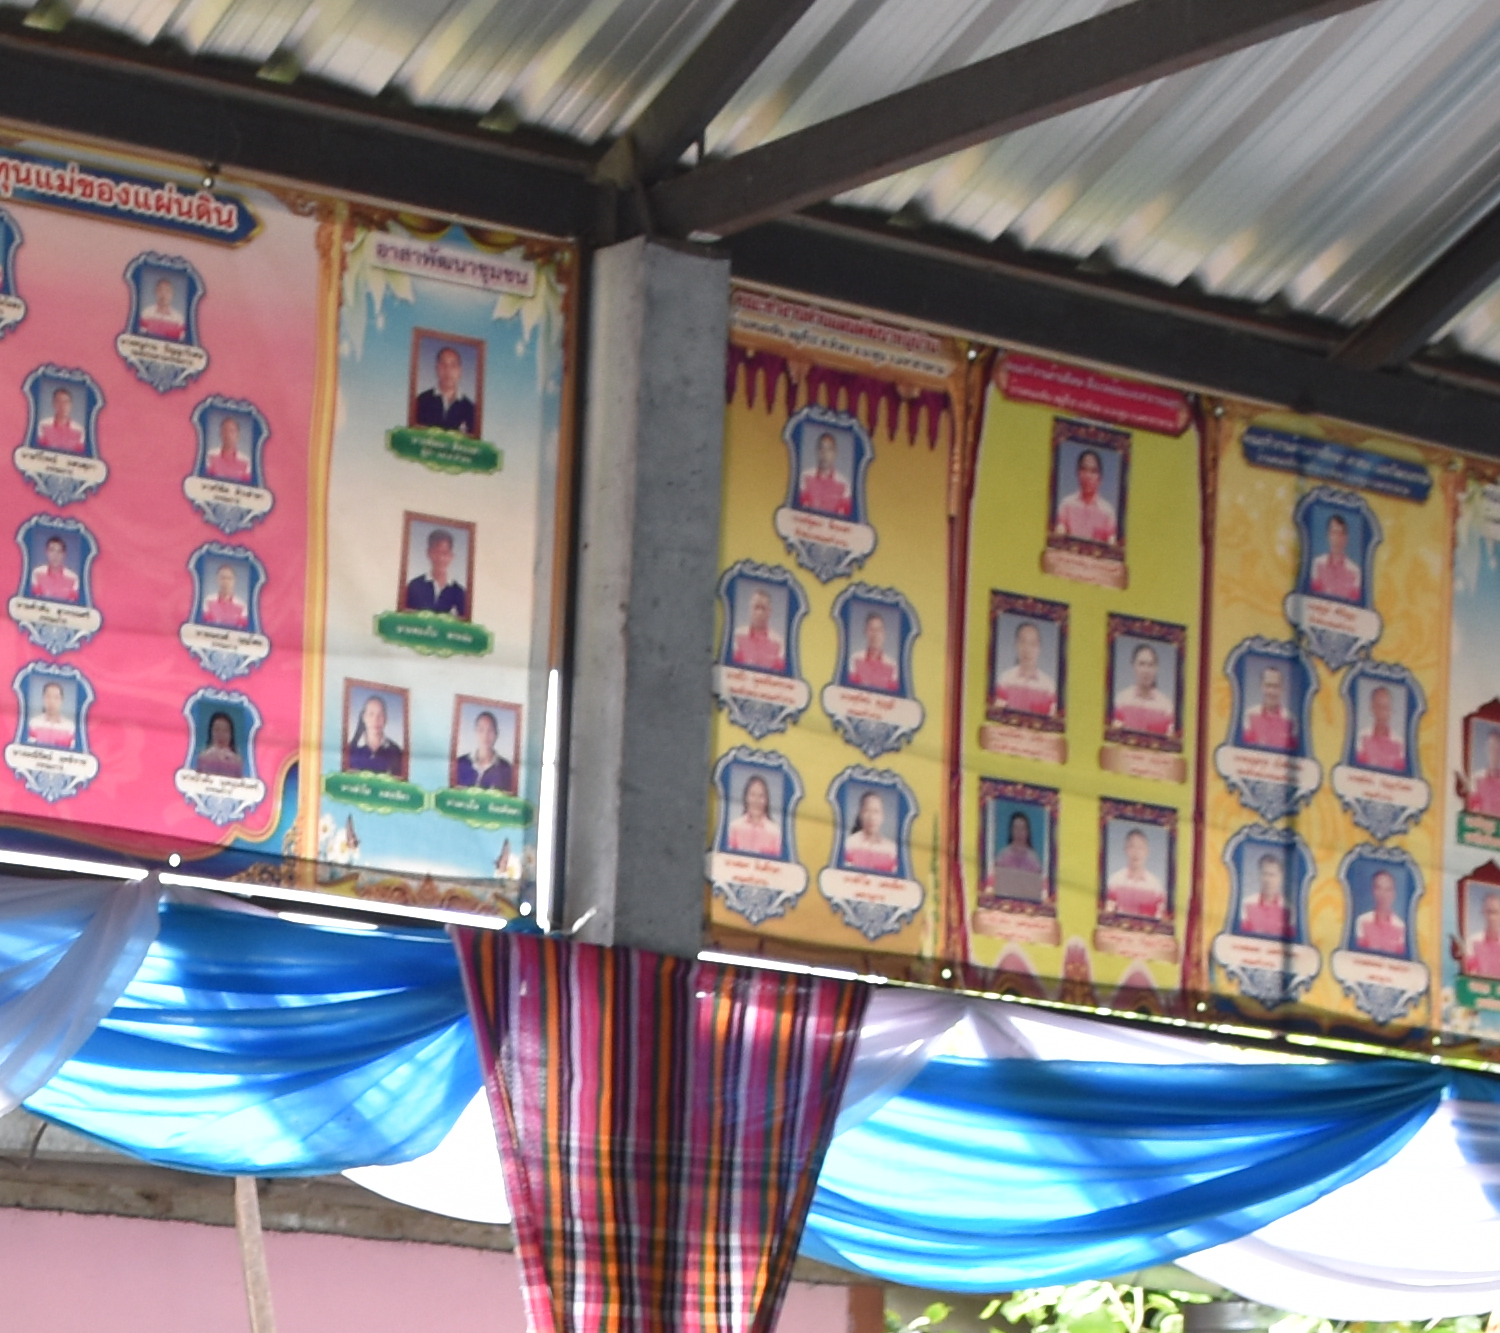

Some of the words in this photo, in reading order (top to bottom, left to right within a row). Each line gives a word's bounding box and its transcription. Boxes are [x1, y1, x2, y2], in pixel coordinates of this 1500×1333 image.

[375, 241, 529, 287] อาสาพัฒนาชุมชน
